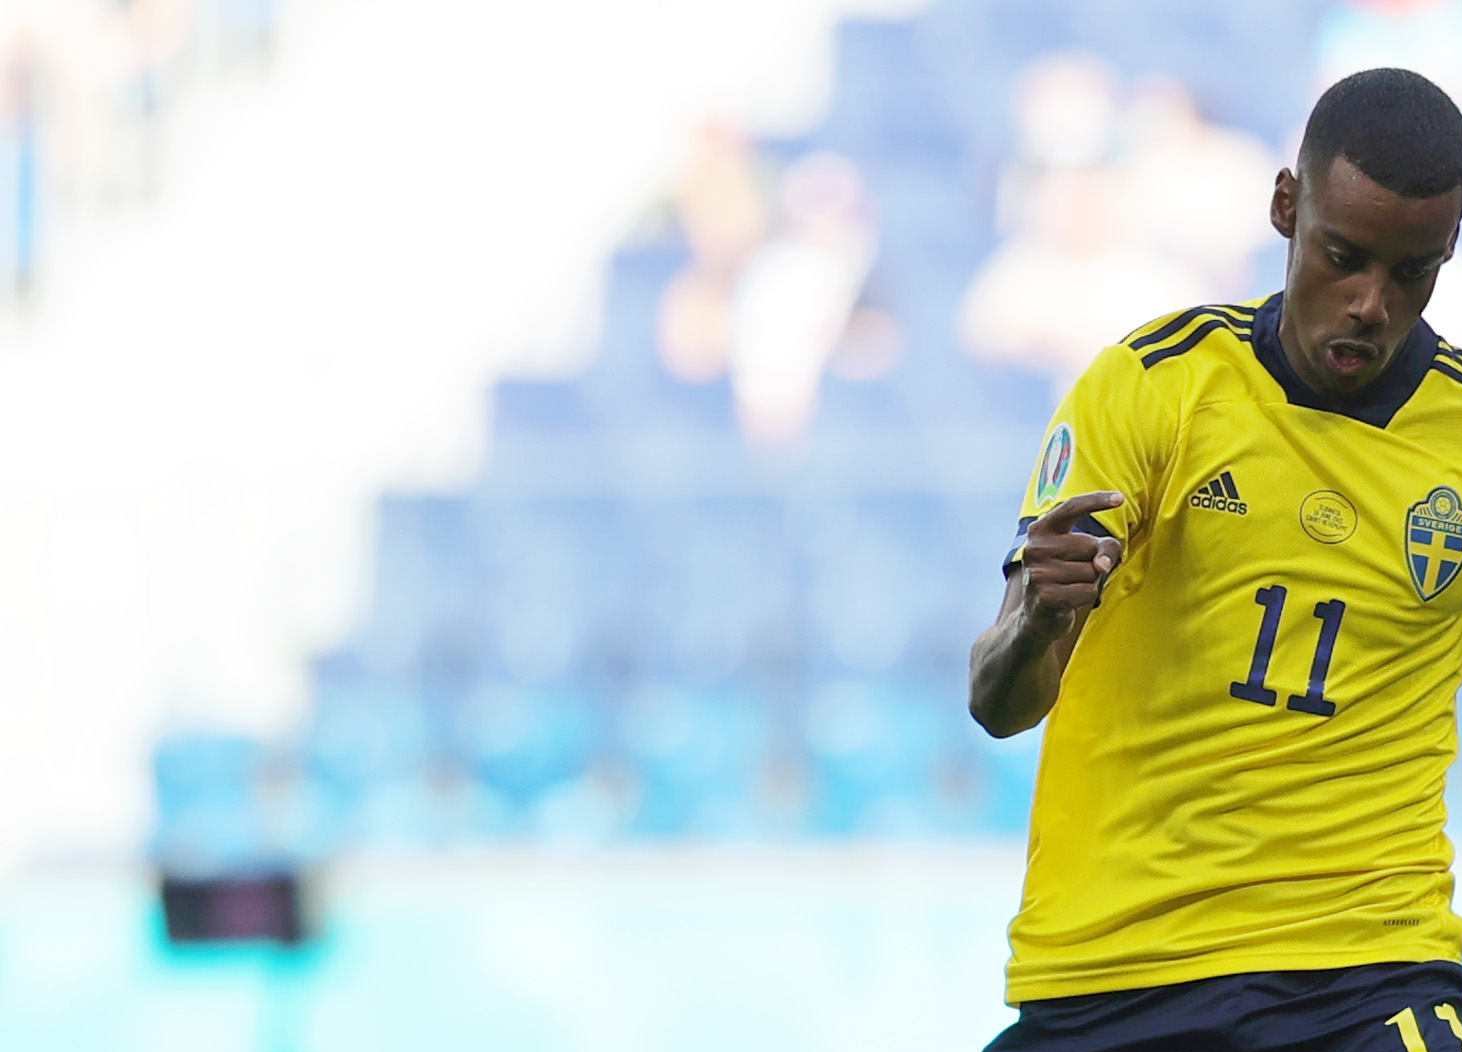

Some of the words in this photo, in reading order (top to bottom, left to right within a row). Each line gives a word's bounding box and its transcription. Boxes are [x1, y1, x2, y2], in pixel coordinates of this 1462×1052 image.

[1190, 494, 1248, 516] adidas
[1417, 517, 1462, 534] SVERIGE
[1230, 584, 1346, 717] 11
